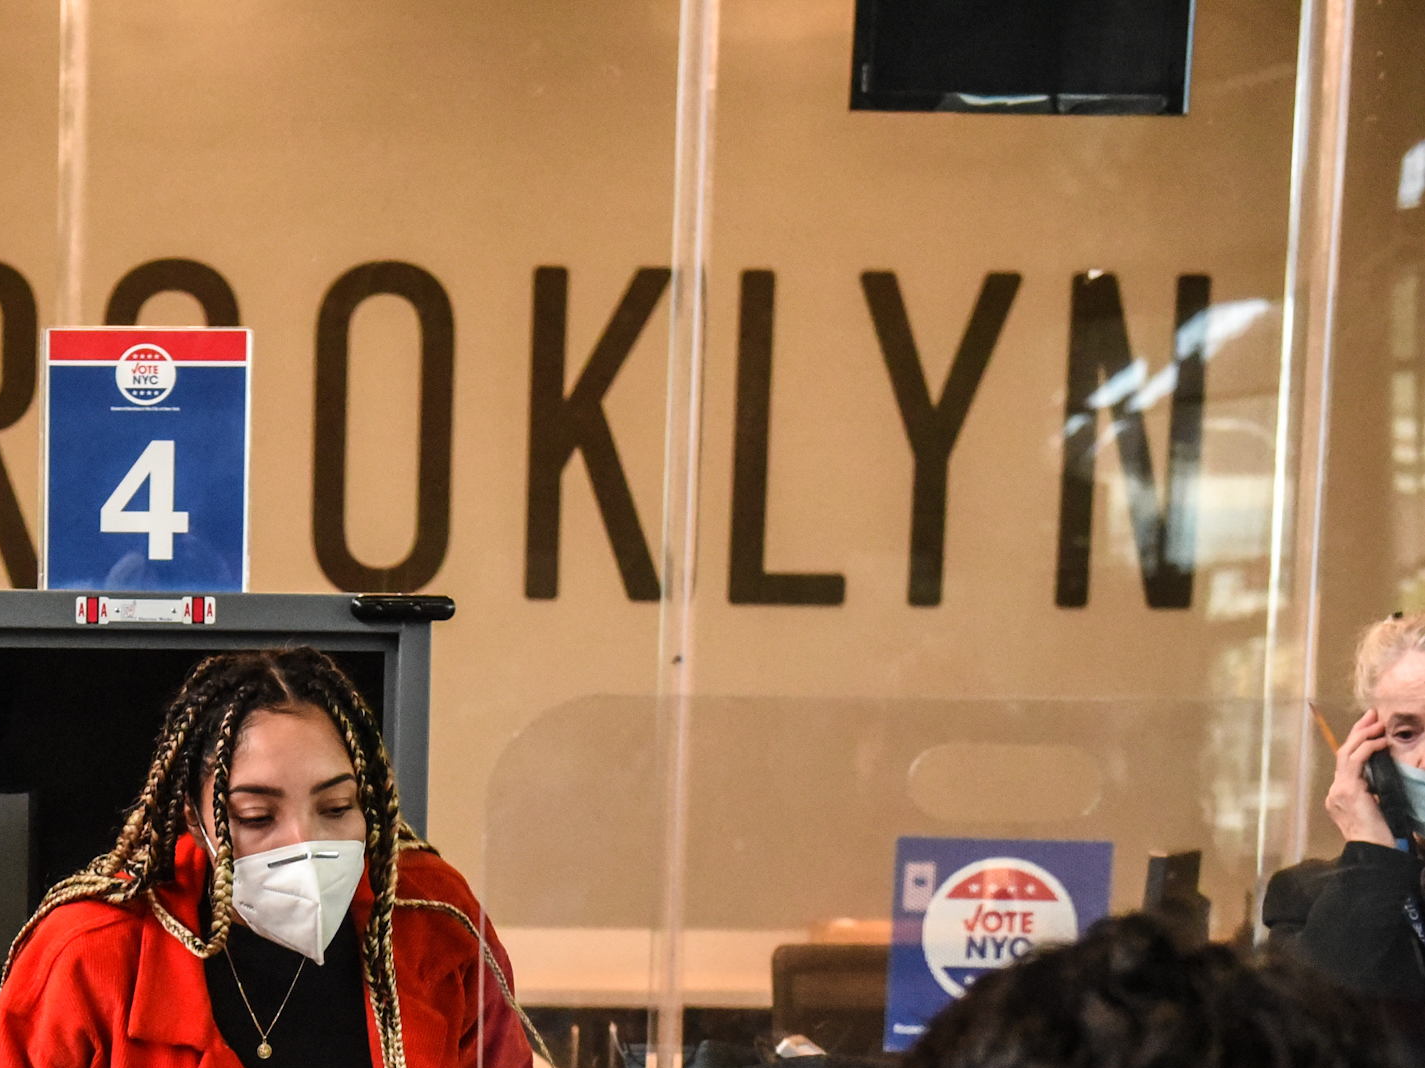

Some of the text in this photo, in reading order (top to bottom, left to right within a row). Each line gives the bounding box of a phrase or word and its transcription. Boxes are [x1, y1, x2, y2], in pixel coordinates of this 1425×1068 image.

[132, 363, 159, 374] VOTE
[133, 375, 159, 385] NYC
[100, 440, 189, 560] 4
[963, 903, 1033, 933] VOTE
